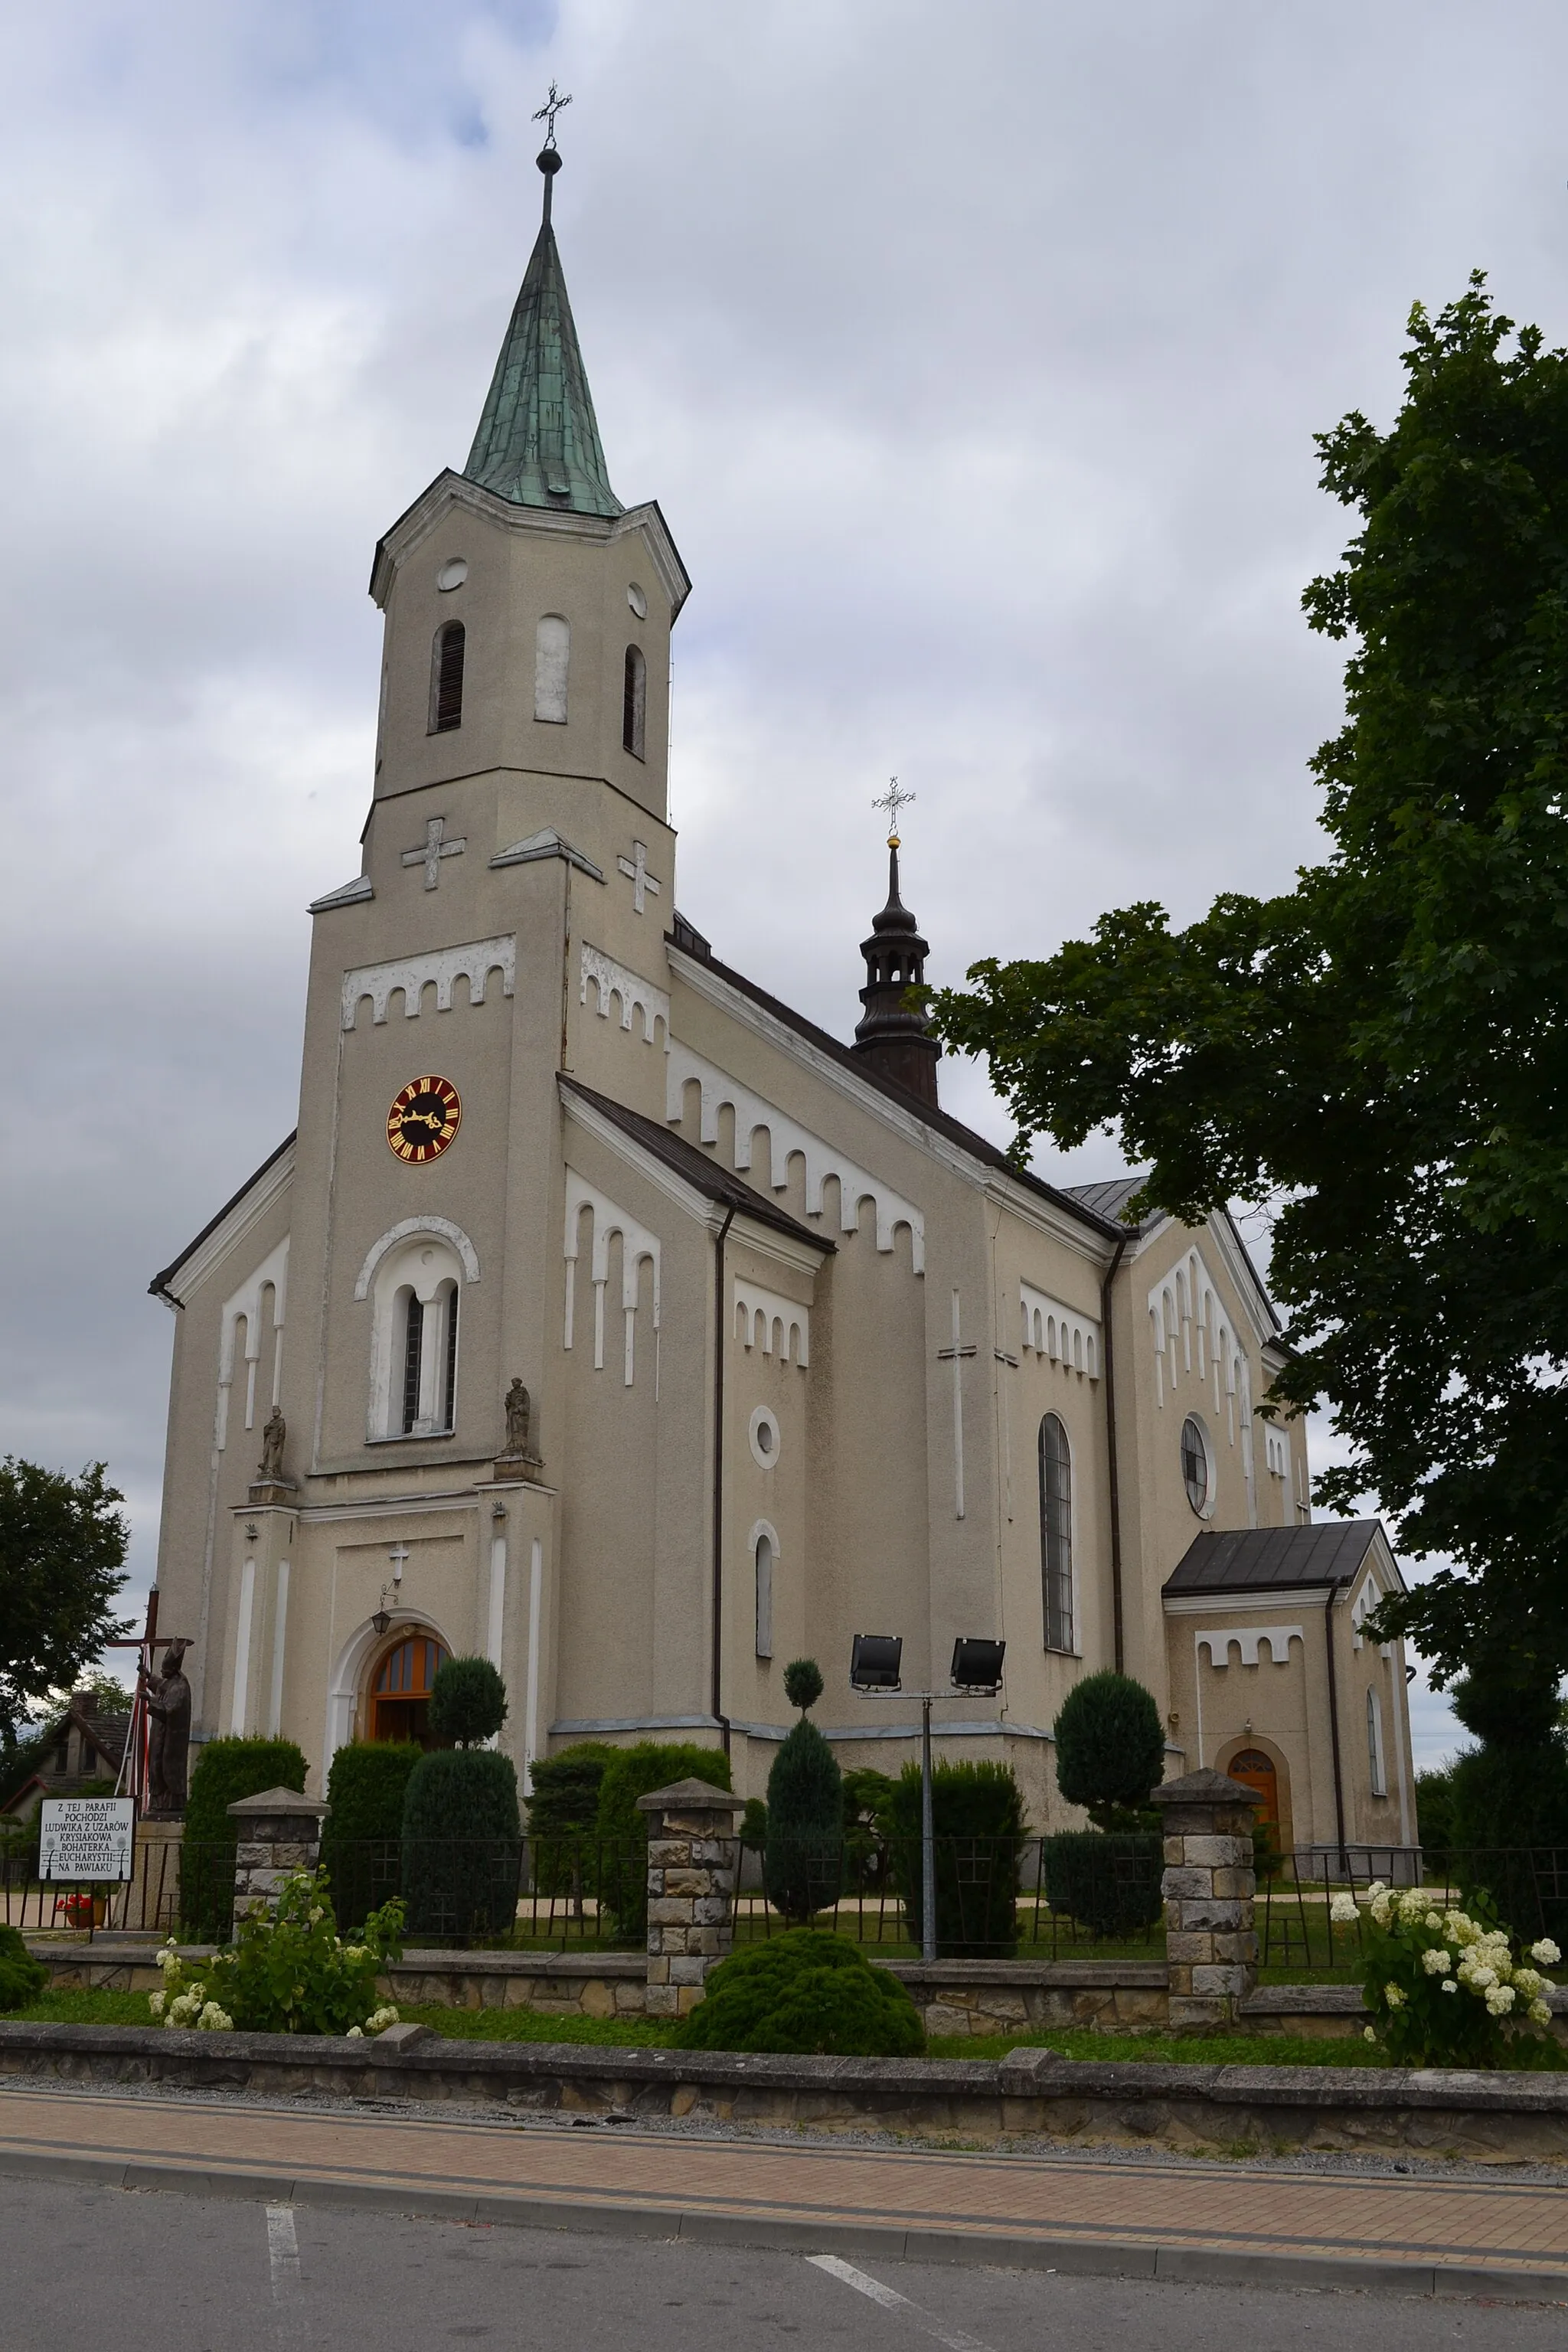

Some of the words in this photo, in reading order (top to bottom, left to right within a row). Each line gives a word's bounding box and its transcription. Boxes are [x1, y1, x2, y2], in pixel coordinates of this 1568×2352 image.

[65, 1813, 107, 1821] POCHODZI
[85, 1823, 90, 1831] Z
[93, 1821, 129, 1831] UZARÓW
[60, 1833, 112, 1841] KRYSIAKOWA
[62, 1843, 109, 1851] BOHATERKA
[60, 1853, 112, 1861] EUCHARYSTII
